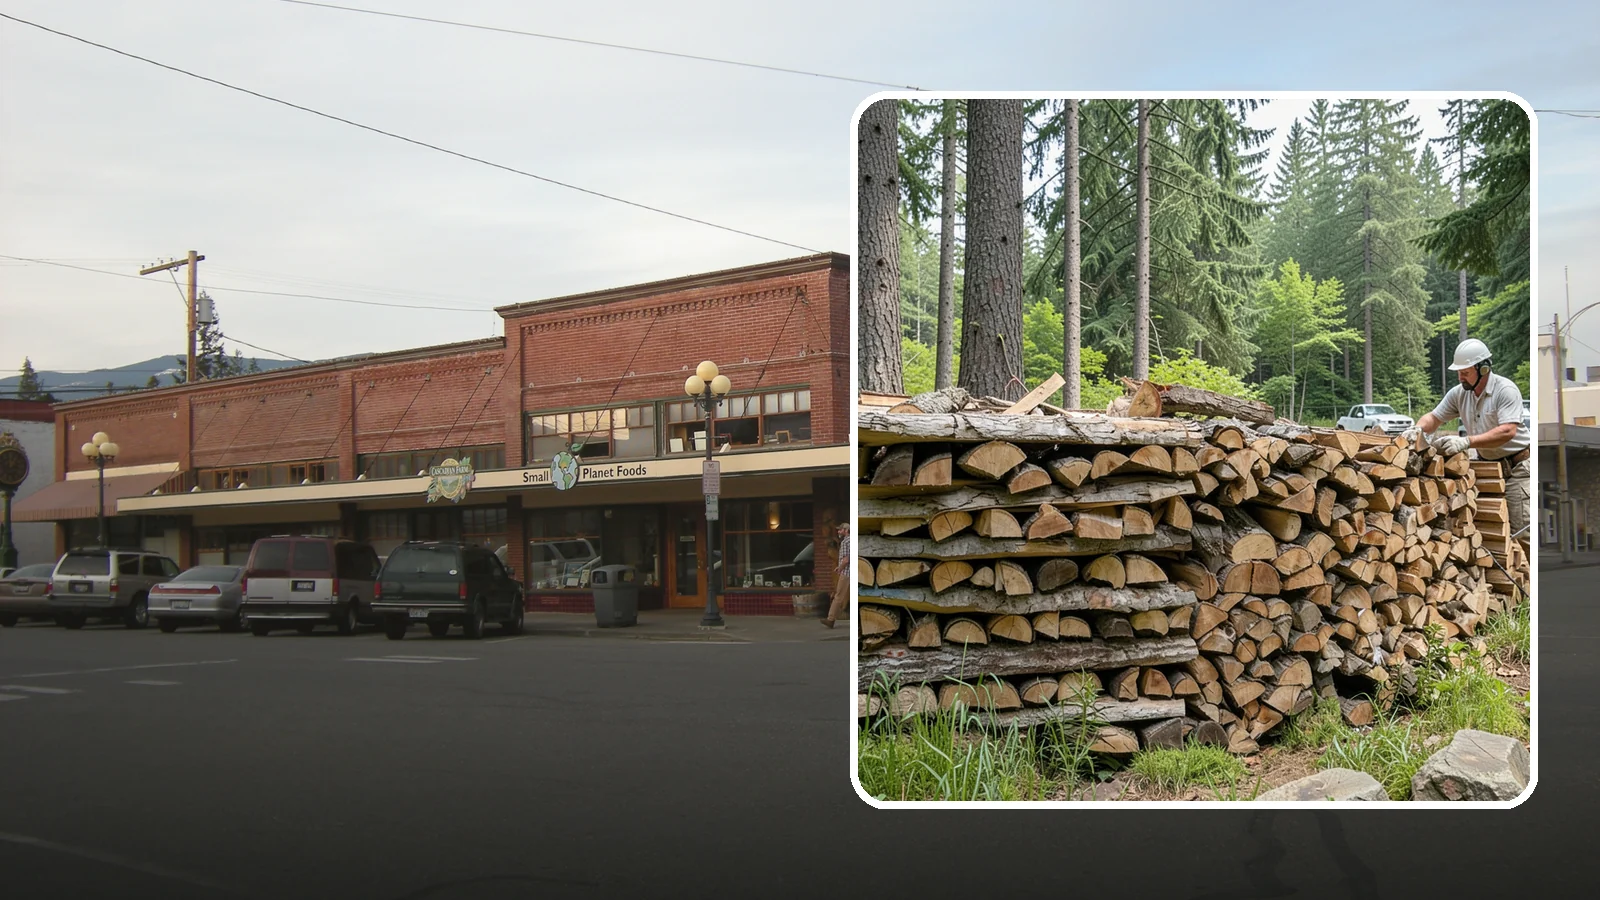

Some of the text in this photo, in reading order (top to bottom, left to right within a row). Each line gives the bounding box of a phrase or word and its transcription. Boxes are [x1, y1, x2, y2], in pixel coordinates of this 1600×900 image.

[523, 464, 647, 483] Small Planet Foods
